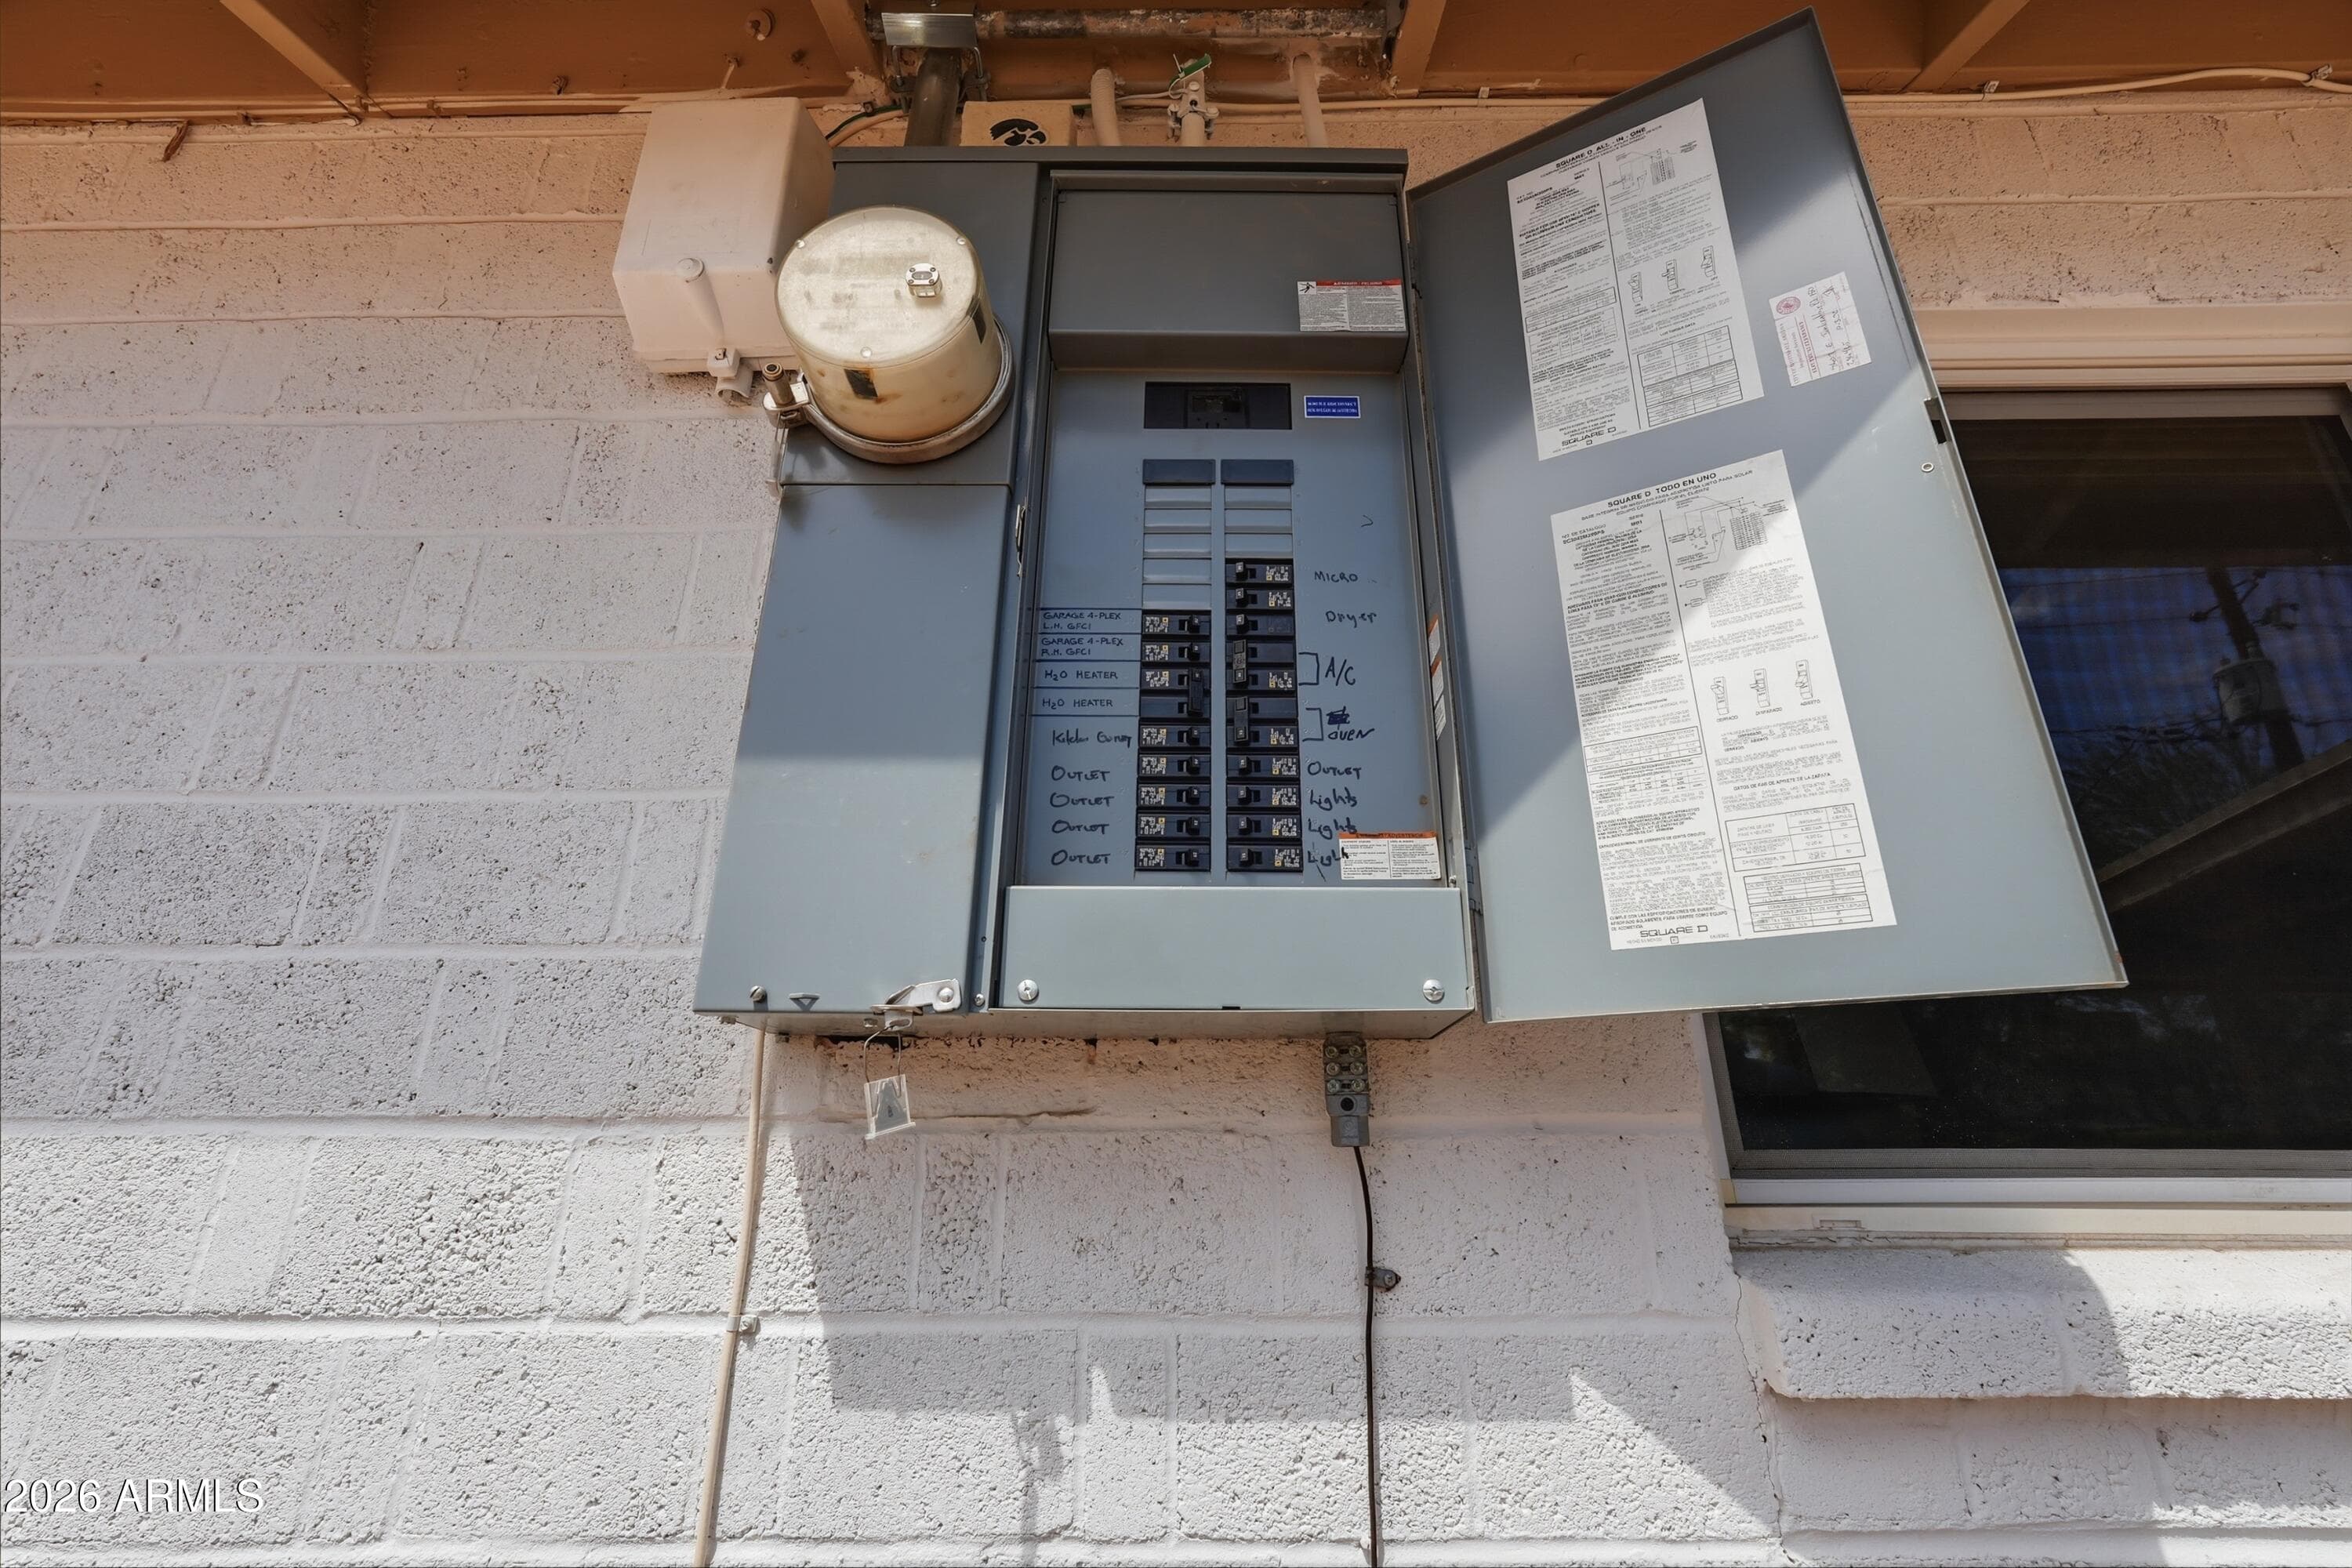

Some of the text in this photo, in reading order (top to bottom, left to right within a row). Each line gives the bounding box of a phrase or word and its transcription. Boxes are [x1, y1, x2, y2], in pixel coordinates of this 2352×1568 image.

[1555, 153, 1584, 168] SQUARE
[1562, 430, 1604, 446] SQUARE
[1607, 492, 1642, 508] SQUARE
[1656, 482, 1680, 494] TODO
[1697, 473, 1716, 484] UNO
[1315, 571, 1358, 583] MICRO
[1326, 611, 1377, 628] Dryer
[1076, 670, 1118, 679] HEATER
[1325, 657, 1356, 686] A/C
[1051, 765, 1110, 782] OUTLET
[1308, 761, 1362, 780] OUTLET
[1050, 793, 1114, 808] OUTLET
[1310, 787, 1357, 811] Lights
[1308, 817, 1357, 840] Lights
[1051, 850, 1111, 865] OUTLET
[1640, 926, 1693, 938] SQUARE
